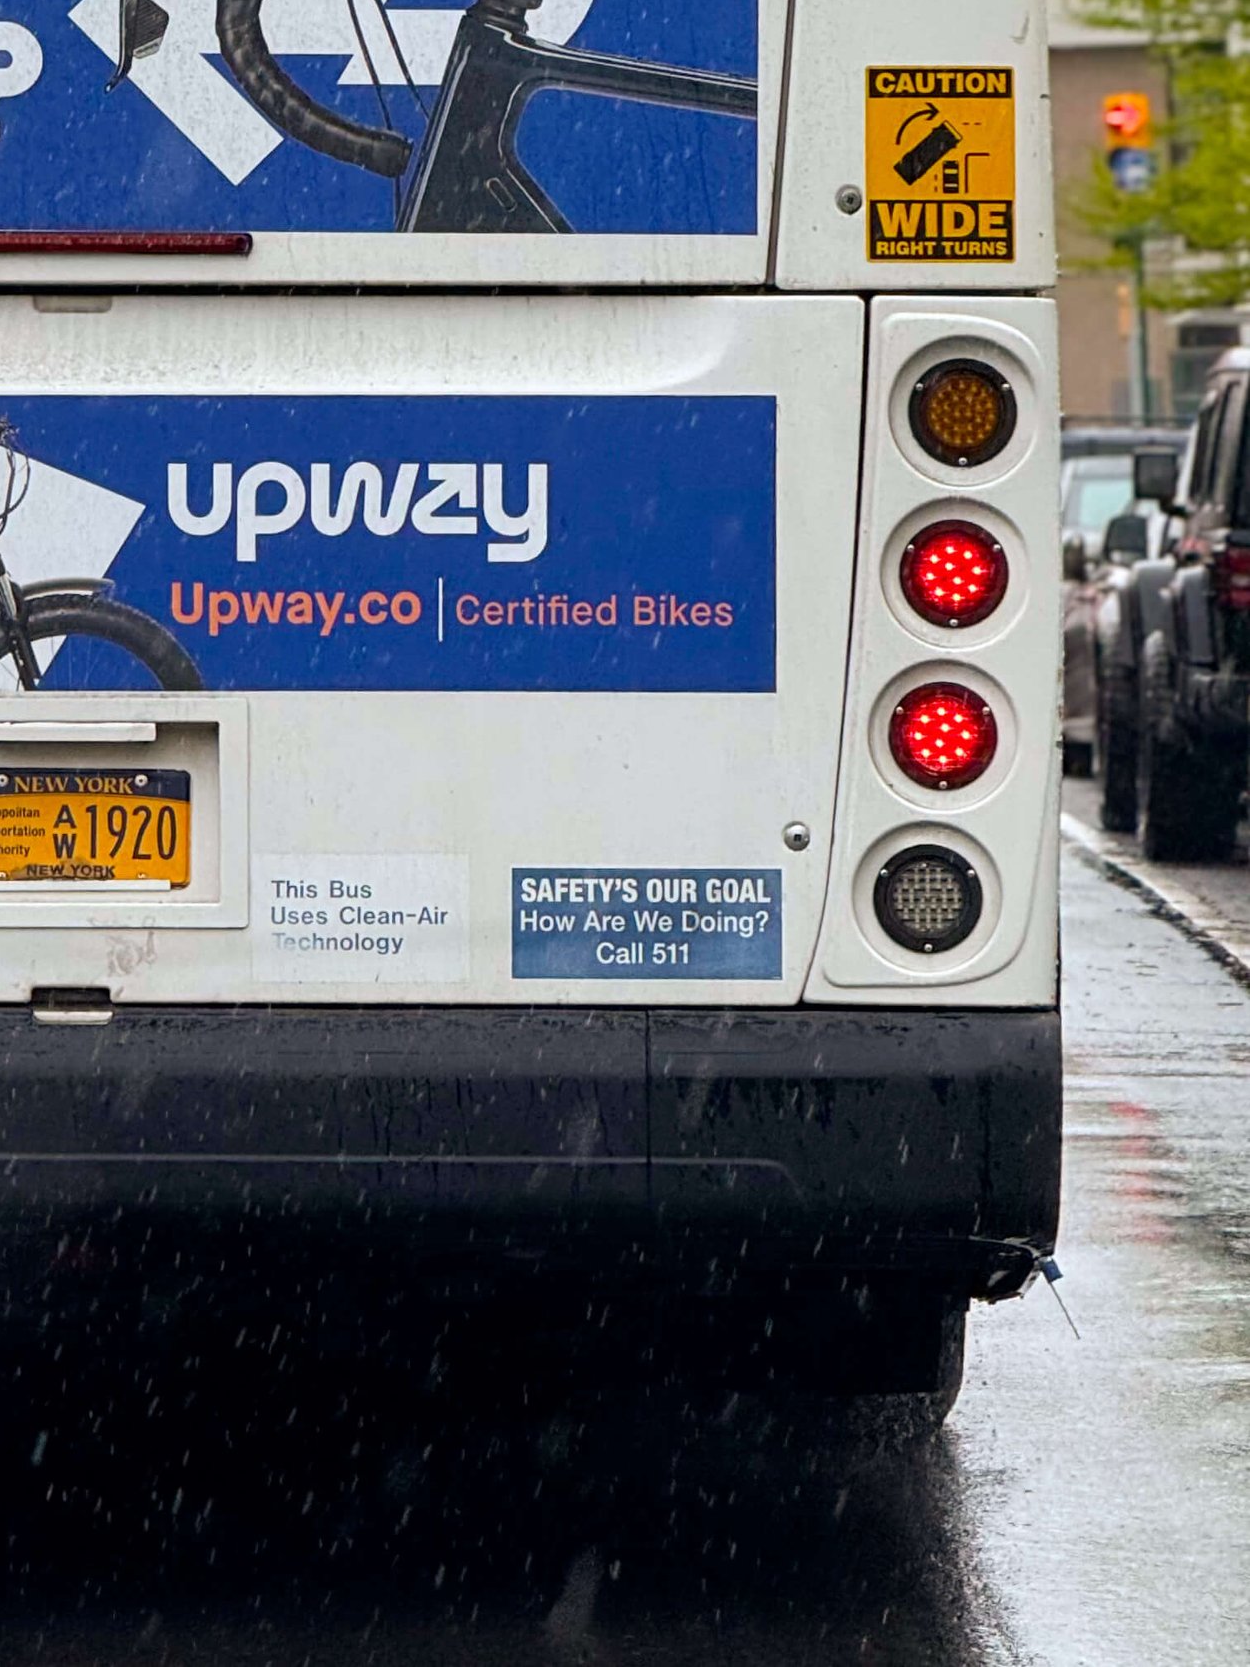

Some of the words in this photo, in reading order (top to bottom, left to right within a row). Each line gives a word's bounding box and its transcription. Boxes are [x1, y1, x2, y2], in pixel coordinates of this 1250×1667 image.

[875, 72, 1006, 94] CAUTION
[876, 202, 1008, 238] WIDE
[876, 241, 936, 256] RIGHT
[941, 241, 1007, 256] TURNS
[171, 582, 421, 636] Upway.co
[456, 594, 616, 626] Certified
[633, 595, 733, 626] Bikes
[14, 776, 68, 793] NEW
[74, 776, 134, 794] YORK
[86, 804, 177, 860] 1920
[27, 863, 64, 877] NEW
[70, 864, 115, 878] YORK
[271, 880, 318, 899] This
[330, 880, 372, 899] Bus
[521, 878, 638, 904] SAFETY'S
[646, 879, 697, 904] OUR
[705, 878, 771, 904] GOAL
[270, 906, 328, 926] Uses
[339, 906, 448, 926] Clean-Air
[520, 911, 576, 933] How
[583, 911, 626, 933] Are
[634, 911, 673, 933] We
[682, 910, 769, 938] Doing?
[272, 933, 404, 955] Technology
[596, 942, 643, 965] Call
[652, 943, 690, 965] 511
